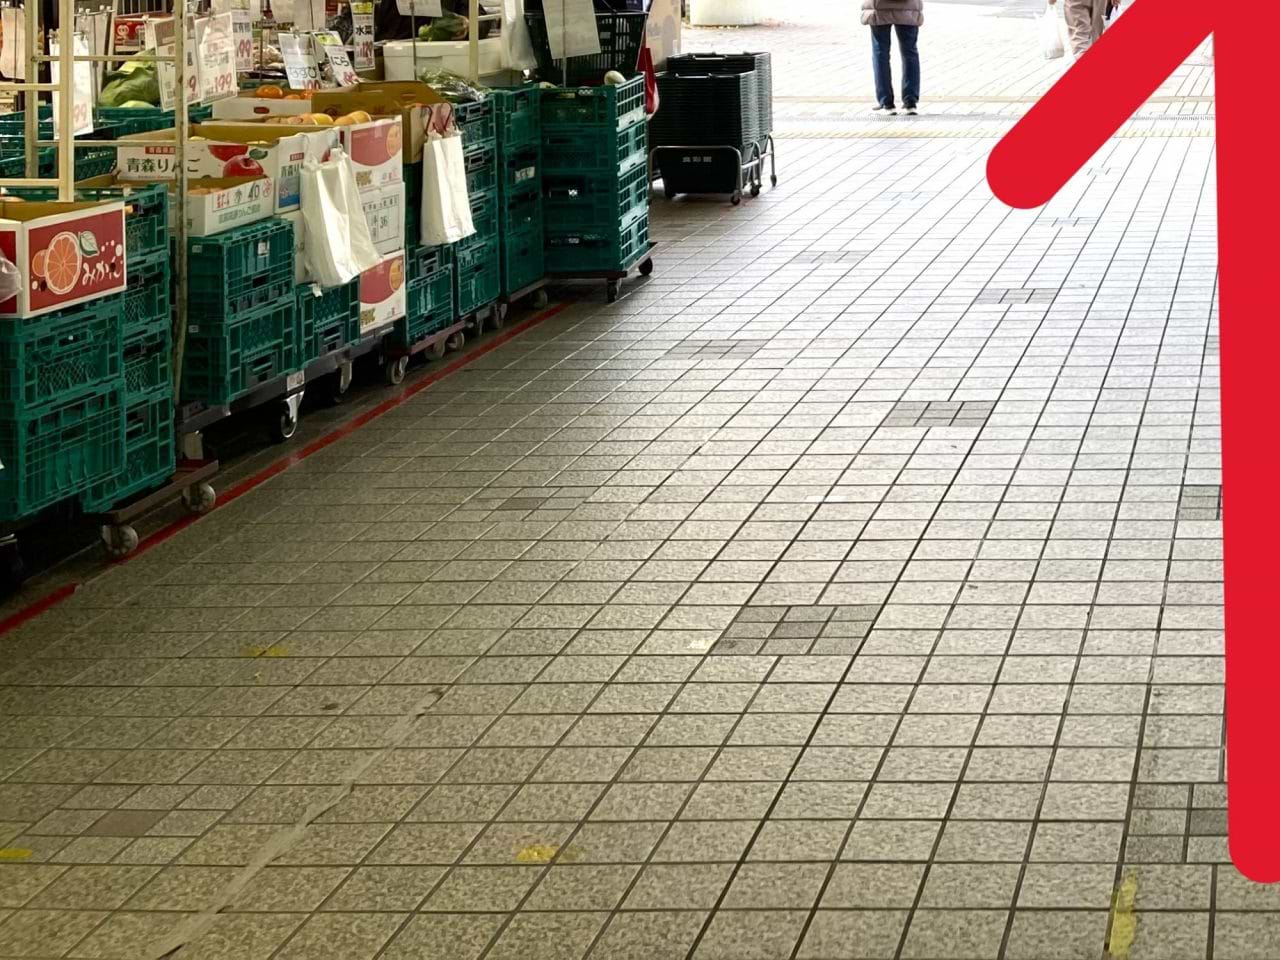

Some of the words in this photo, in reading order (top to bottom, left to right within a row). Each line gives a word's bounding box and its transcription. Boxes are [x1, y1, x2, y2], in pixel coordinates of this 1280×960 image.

[355, 24, 373, 36] 水菜
[330, 55, 350, 68] にら
[215, 73, 233, 93] 199
